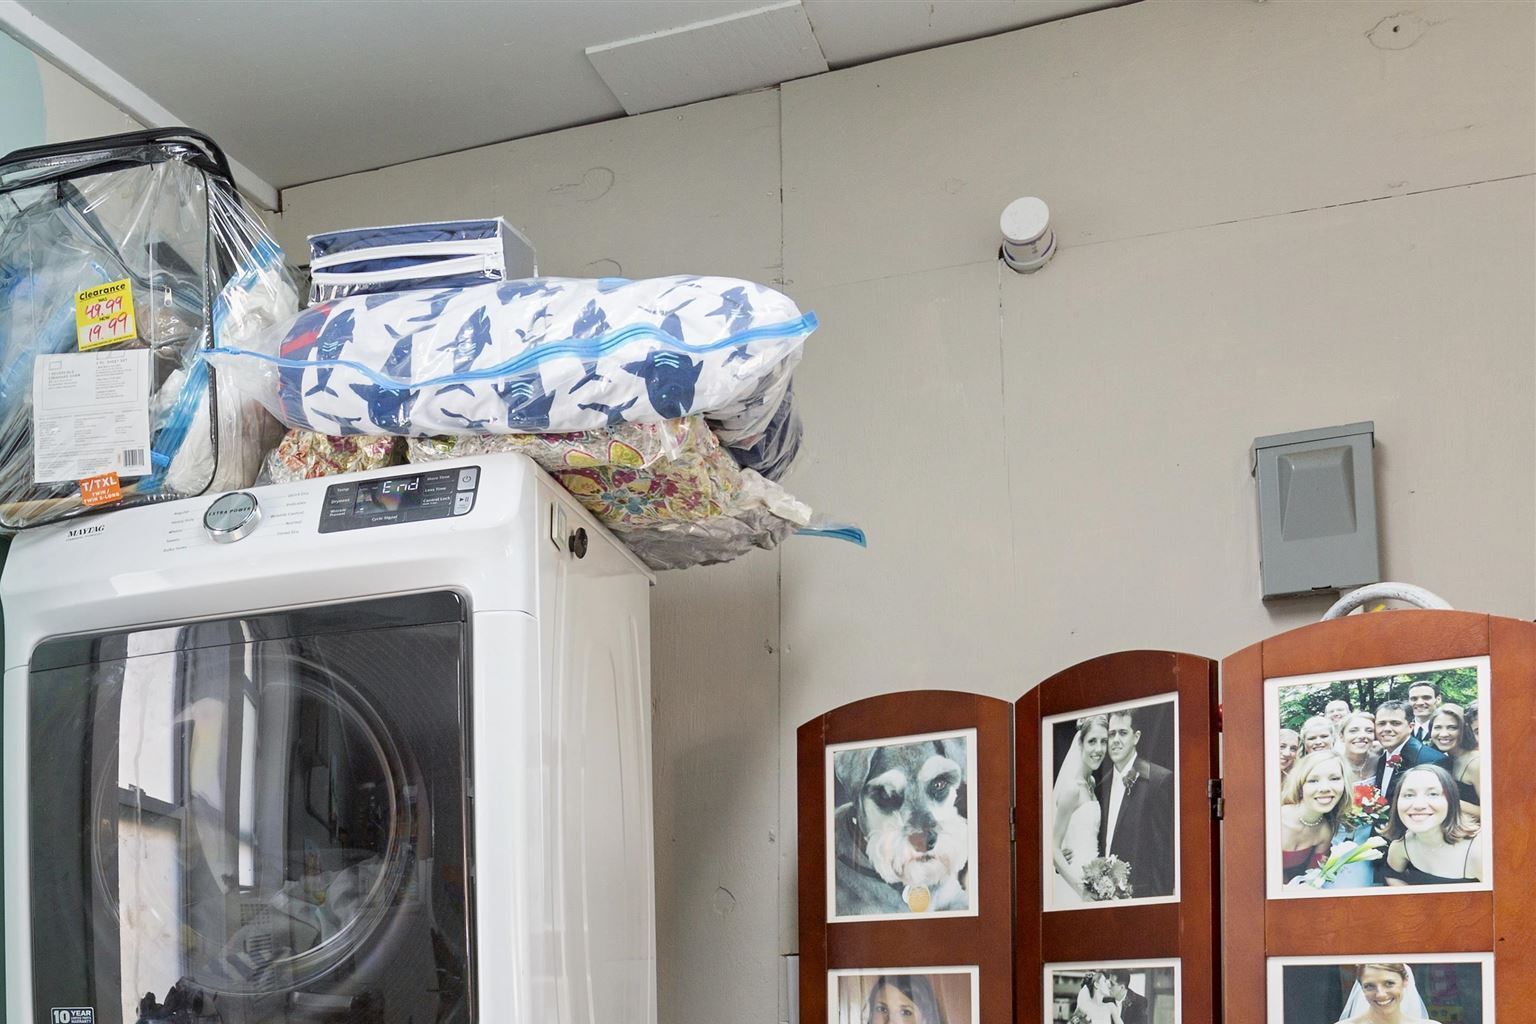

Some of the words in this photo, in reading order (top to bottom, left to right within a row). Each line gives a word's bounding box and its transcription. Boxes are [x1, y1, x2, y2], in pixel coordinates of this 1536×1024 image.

[79, 283, 126, 301] Clearance
[85, 296, 123, 319] 49.99
[88, 312, 128, 342] 19.99
[82, 476, 118, 492] T/TXL
[67, 525, 105, 537] MAYTAG
[53, 1010, 71, 1024] 10
